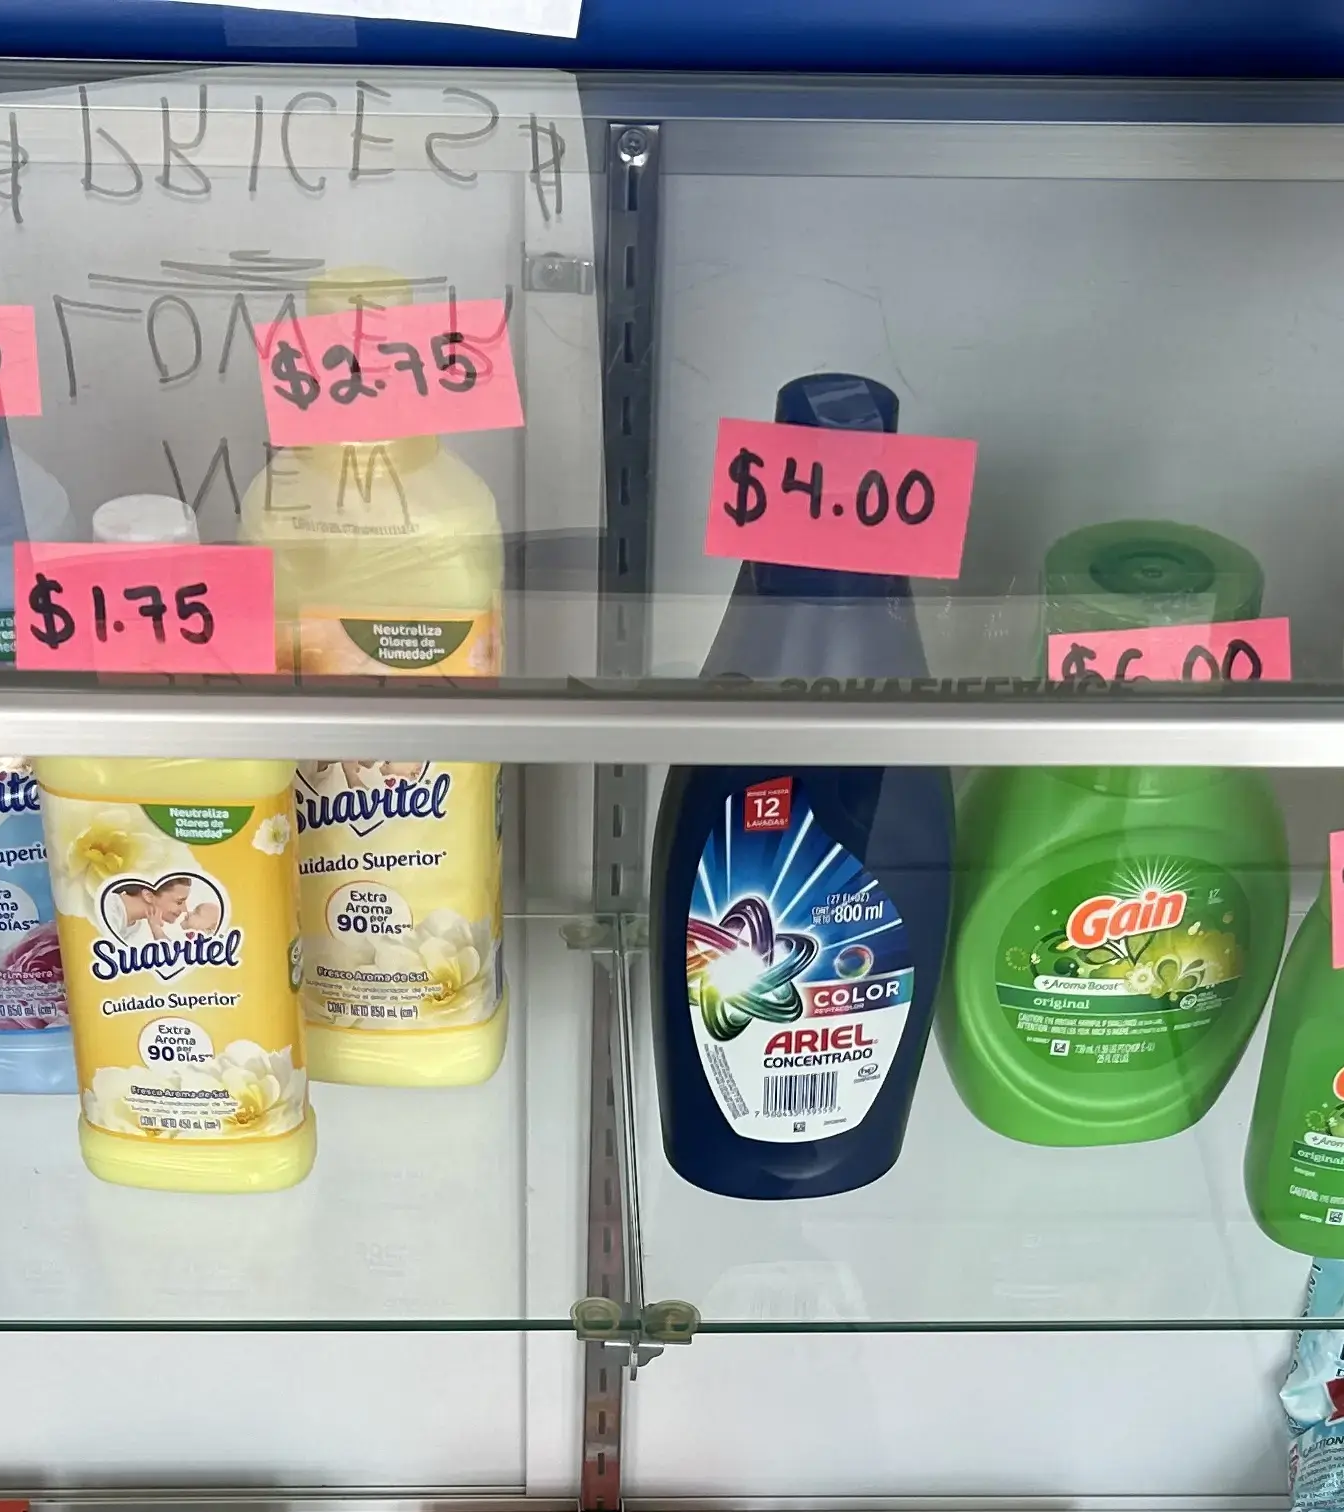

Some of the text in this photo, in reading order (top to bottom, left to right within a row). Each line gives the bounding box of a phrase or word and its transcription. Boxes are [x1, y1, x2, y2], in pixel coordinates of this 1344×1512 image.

[271, 332, 477, 409] $2.75
[723, 447, 935, 527] $4.00
[28, 573, 215, 649] $1.75
[374, 623, 442, 638] Neutraliza
[296, 773, 450, 834] Suavitel
[754, 799, 780, 819] 12
[299, 856, 358, 875] uidado
[350, 891, 387, 902] Extra
[346, 904, 392, 914] Aroma
[338, 915, 367, 933] 90
[1068, 891, 1186, 948] Gain
[92, 929, 239, 979] Suavitel
[102, 995, 165, 1015] Cuidado
[813, 981, 900, 1009] COLOR
[158, 1024, 191, 1035] Extra
[764, 1024, 873, 1055] ARIEL
[155, 1036, 196, 1047] Aroma
[148, 1046, 174, 1061] 90
[763, 1048, 873, 1069] CONCENTRADO
